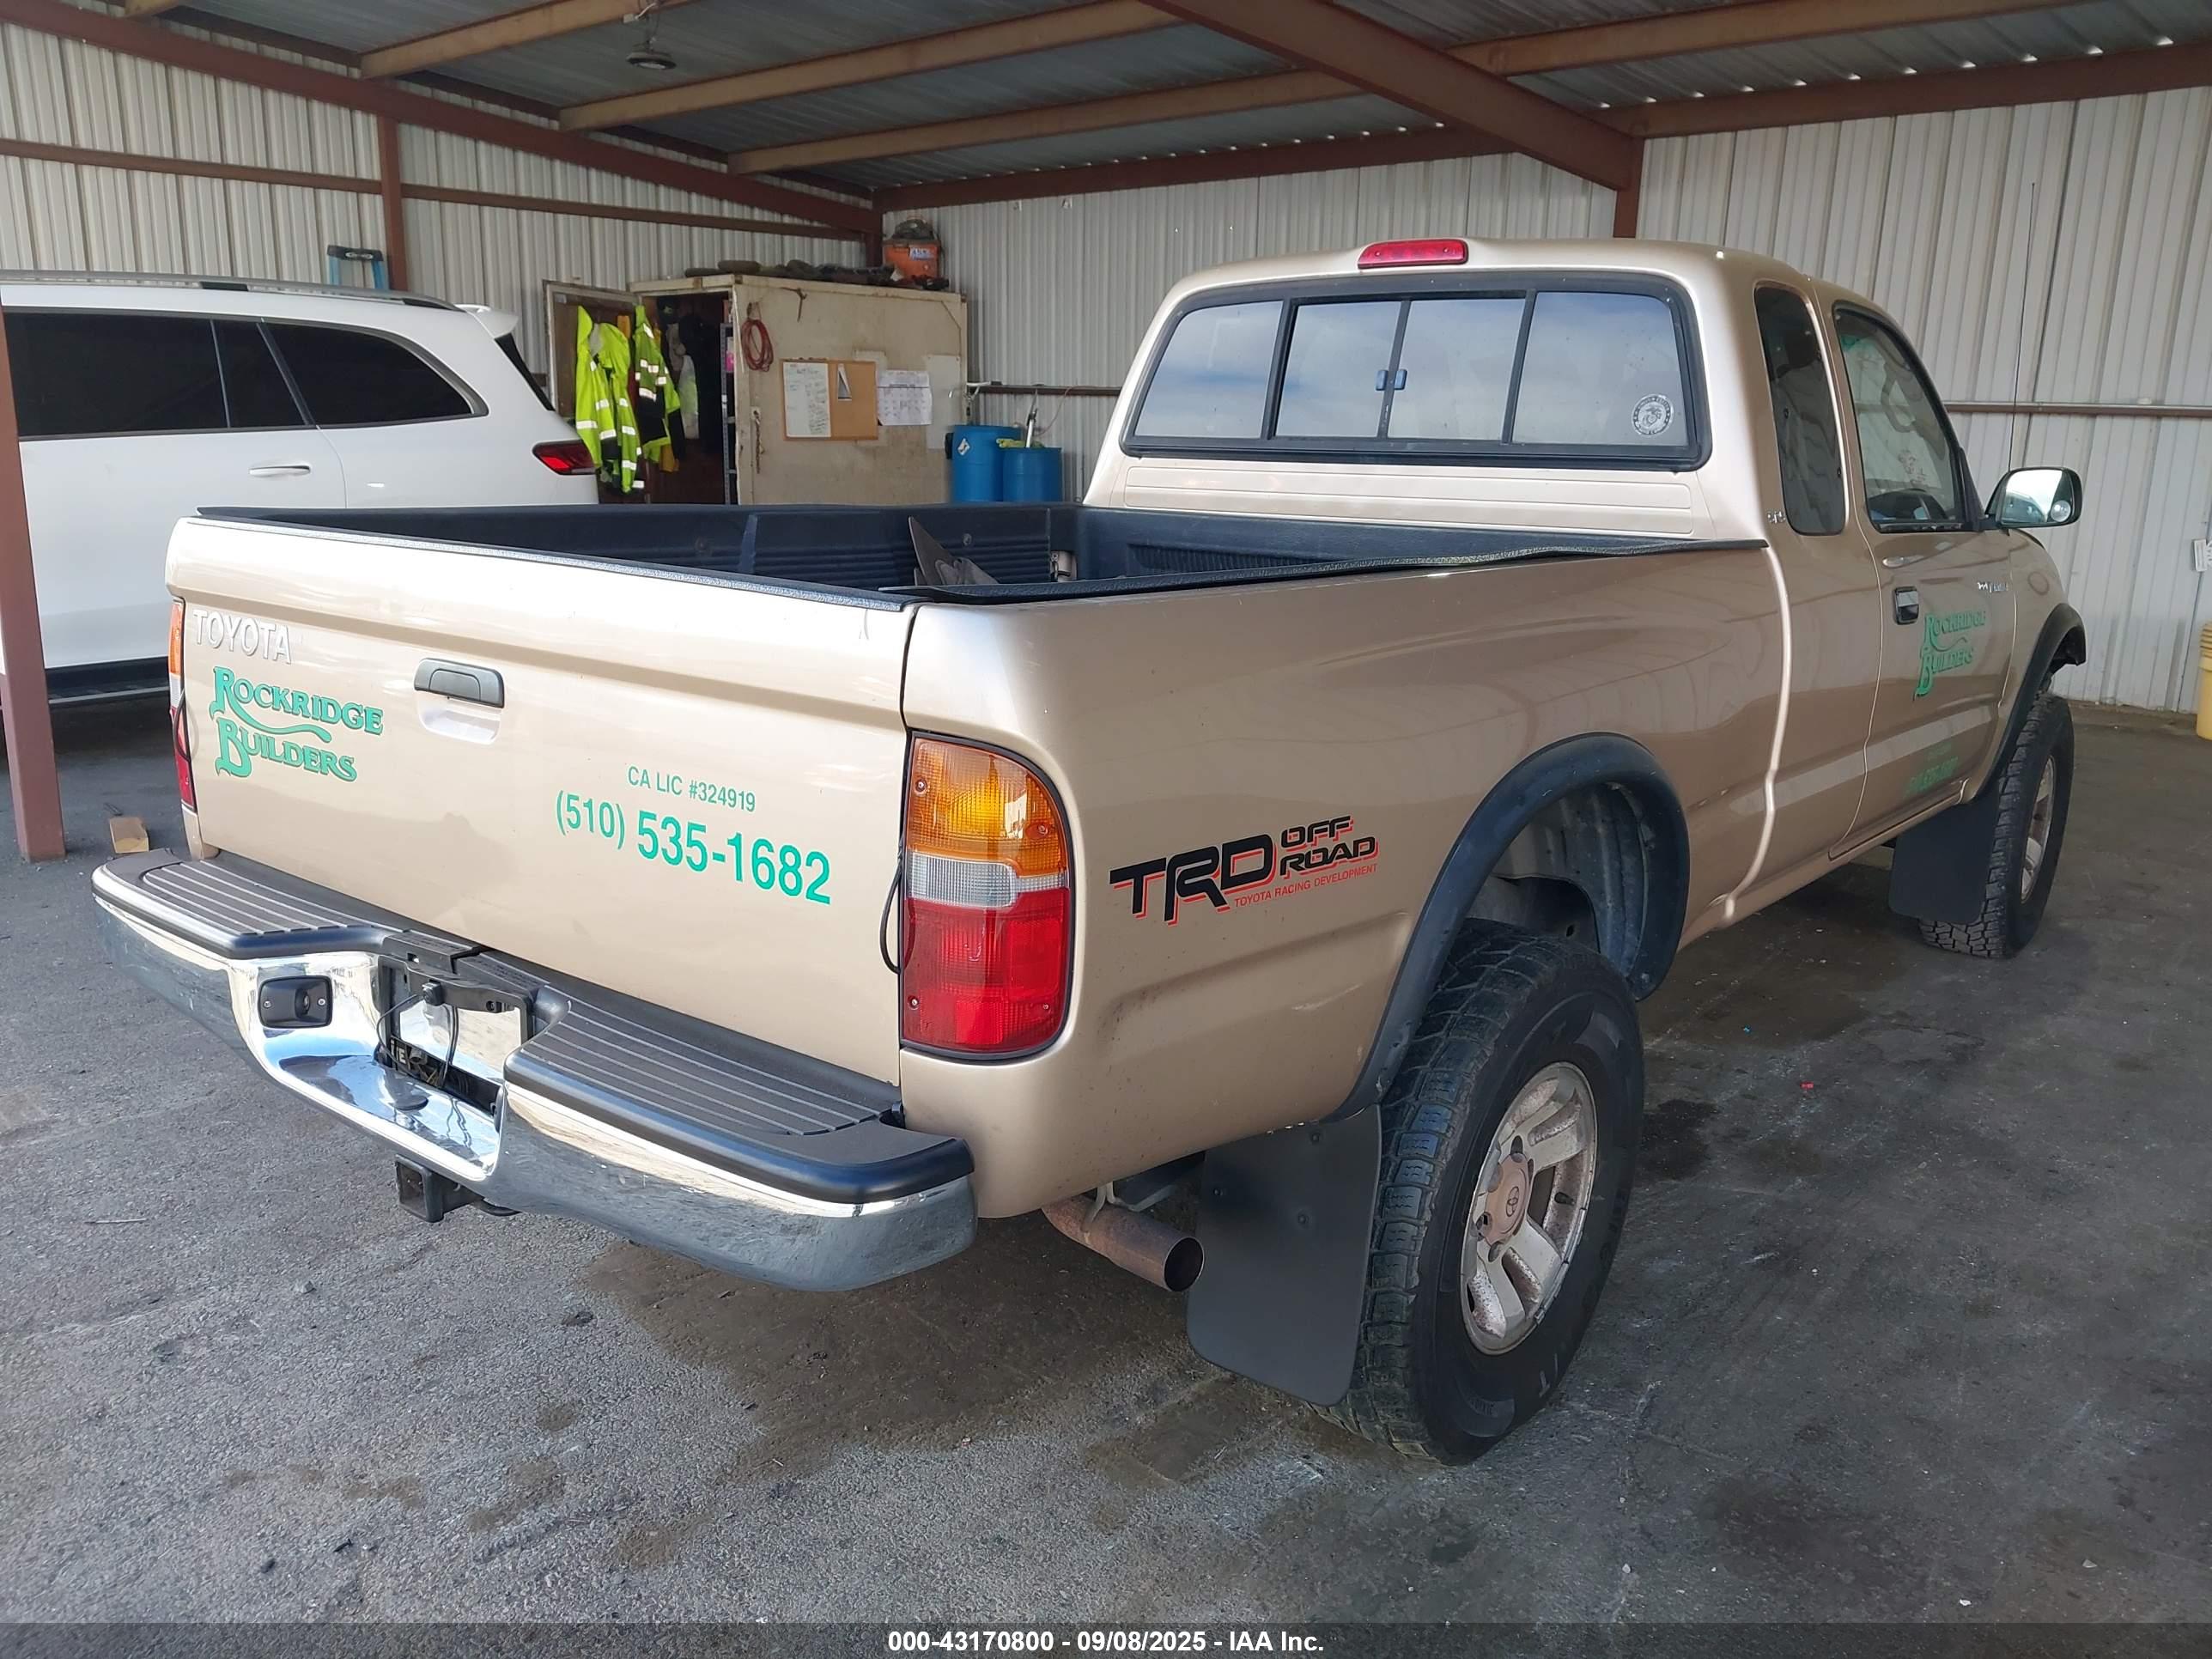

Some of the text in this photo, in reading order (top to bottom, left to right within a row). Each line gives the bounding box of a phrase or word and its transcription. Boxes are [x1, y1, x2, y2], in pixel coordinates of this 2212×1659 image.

[194, 610, 291, 664] TOYOTA
[209, 665, 385, 743] ROCKRIDGE
[215, 717, 357, 782] BUILDERS
[628, 766, 756, 812] CA LIC #324919
[556, 790, 831, 905] (510) 535-1682
[1279, 836, 1379, 880] ROAD
[1280, 815, 1354, 852] OFF
[1109, 833, 1278, 927] TRD
[1234, 862, 1378, 908] TOYOTA RACING DEVELOPMENT
